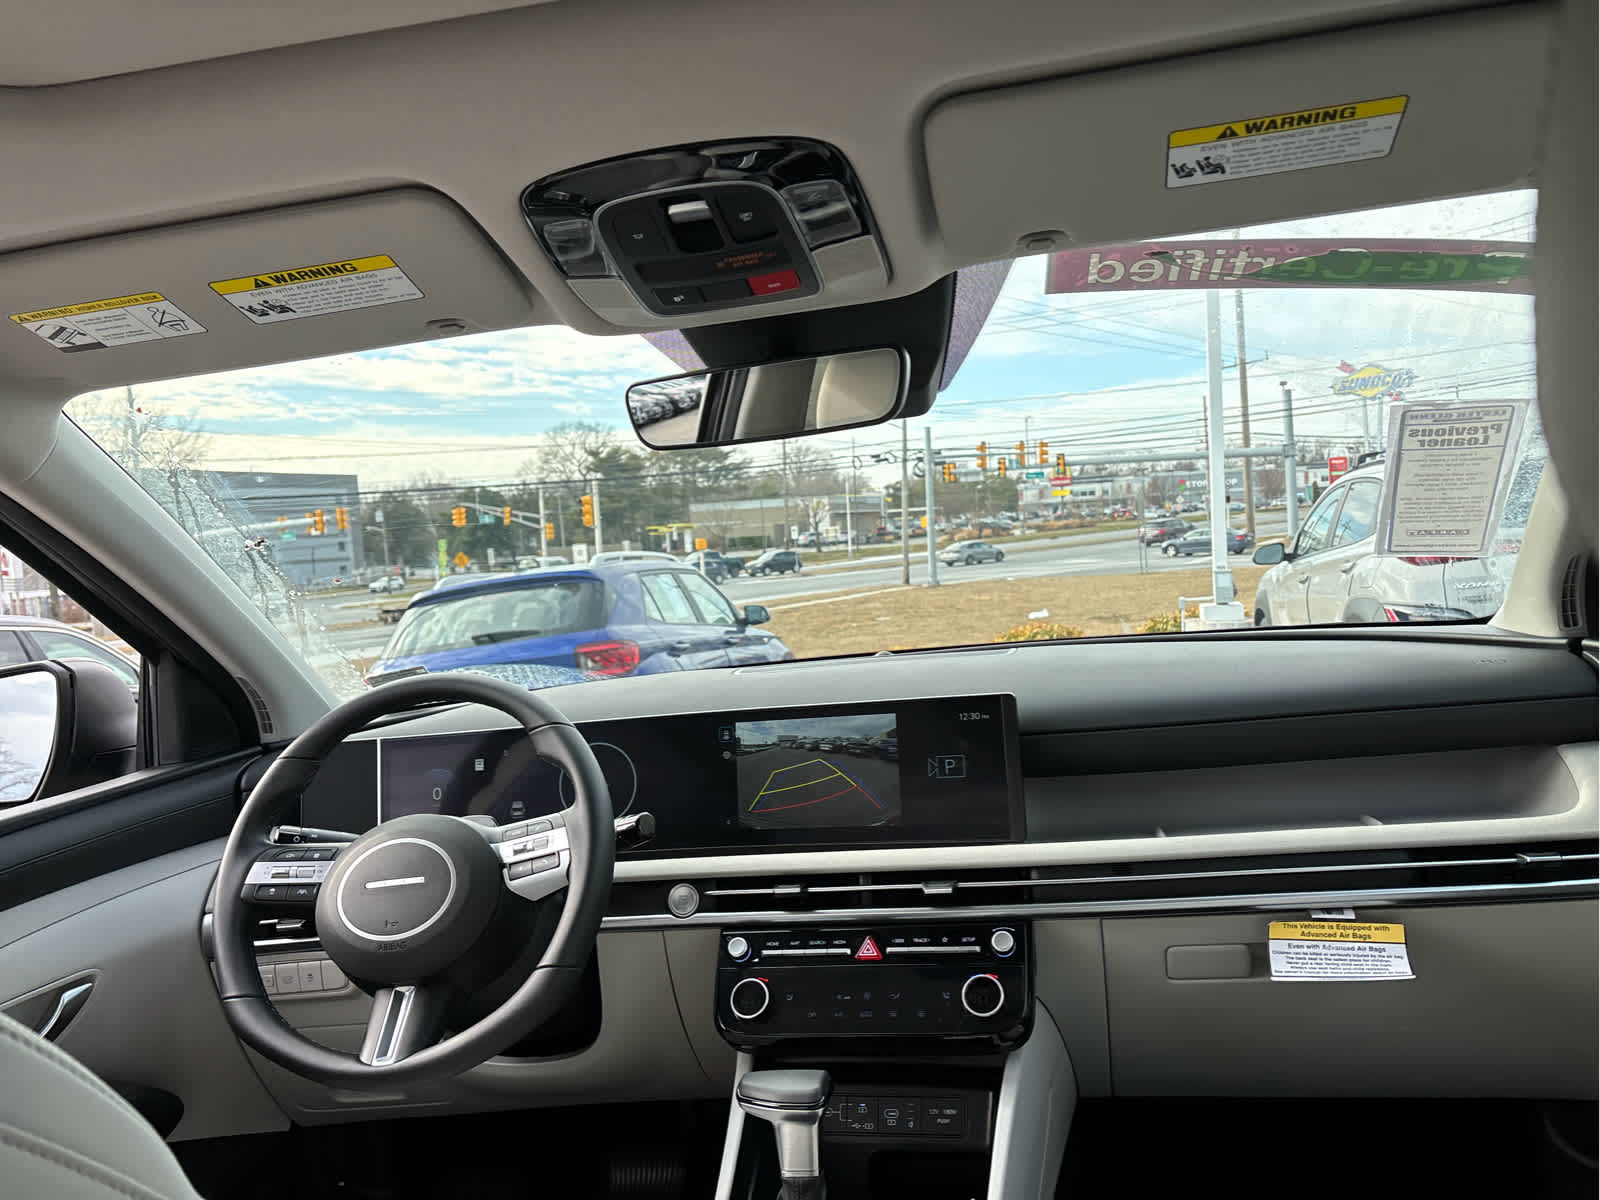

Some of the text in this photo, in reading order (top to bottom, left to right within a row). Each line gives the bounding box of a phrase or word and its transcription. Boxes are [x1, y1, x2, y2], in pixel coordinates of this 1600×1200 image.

[1244, 106, 1358, 135] WARNING
[269, 263, 358, 286] WARNING
[1338, 374, 1402, 393] SUNOCO
[959, 712, 980, 720] 12:30
[432, 787, 442, 800] 0
[1336, 924, 1372, 932] Equipped
[1352, 932, 1372, 940] Bags
